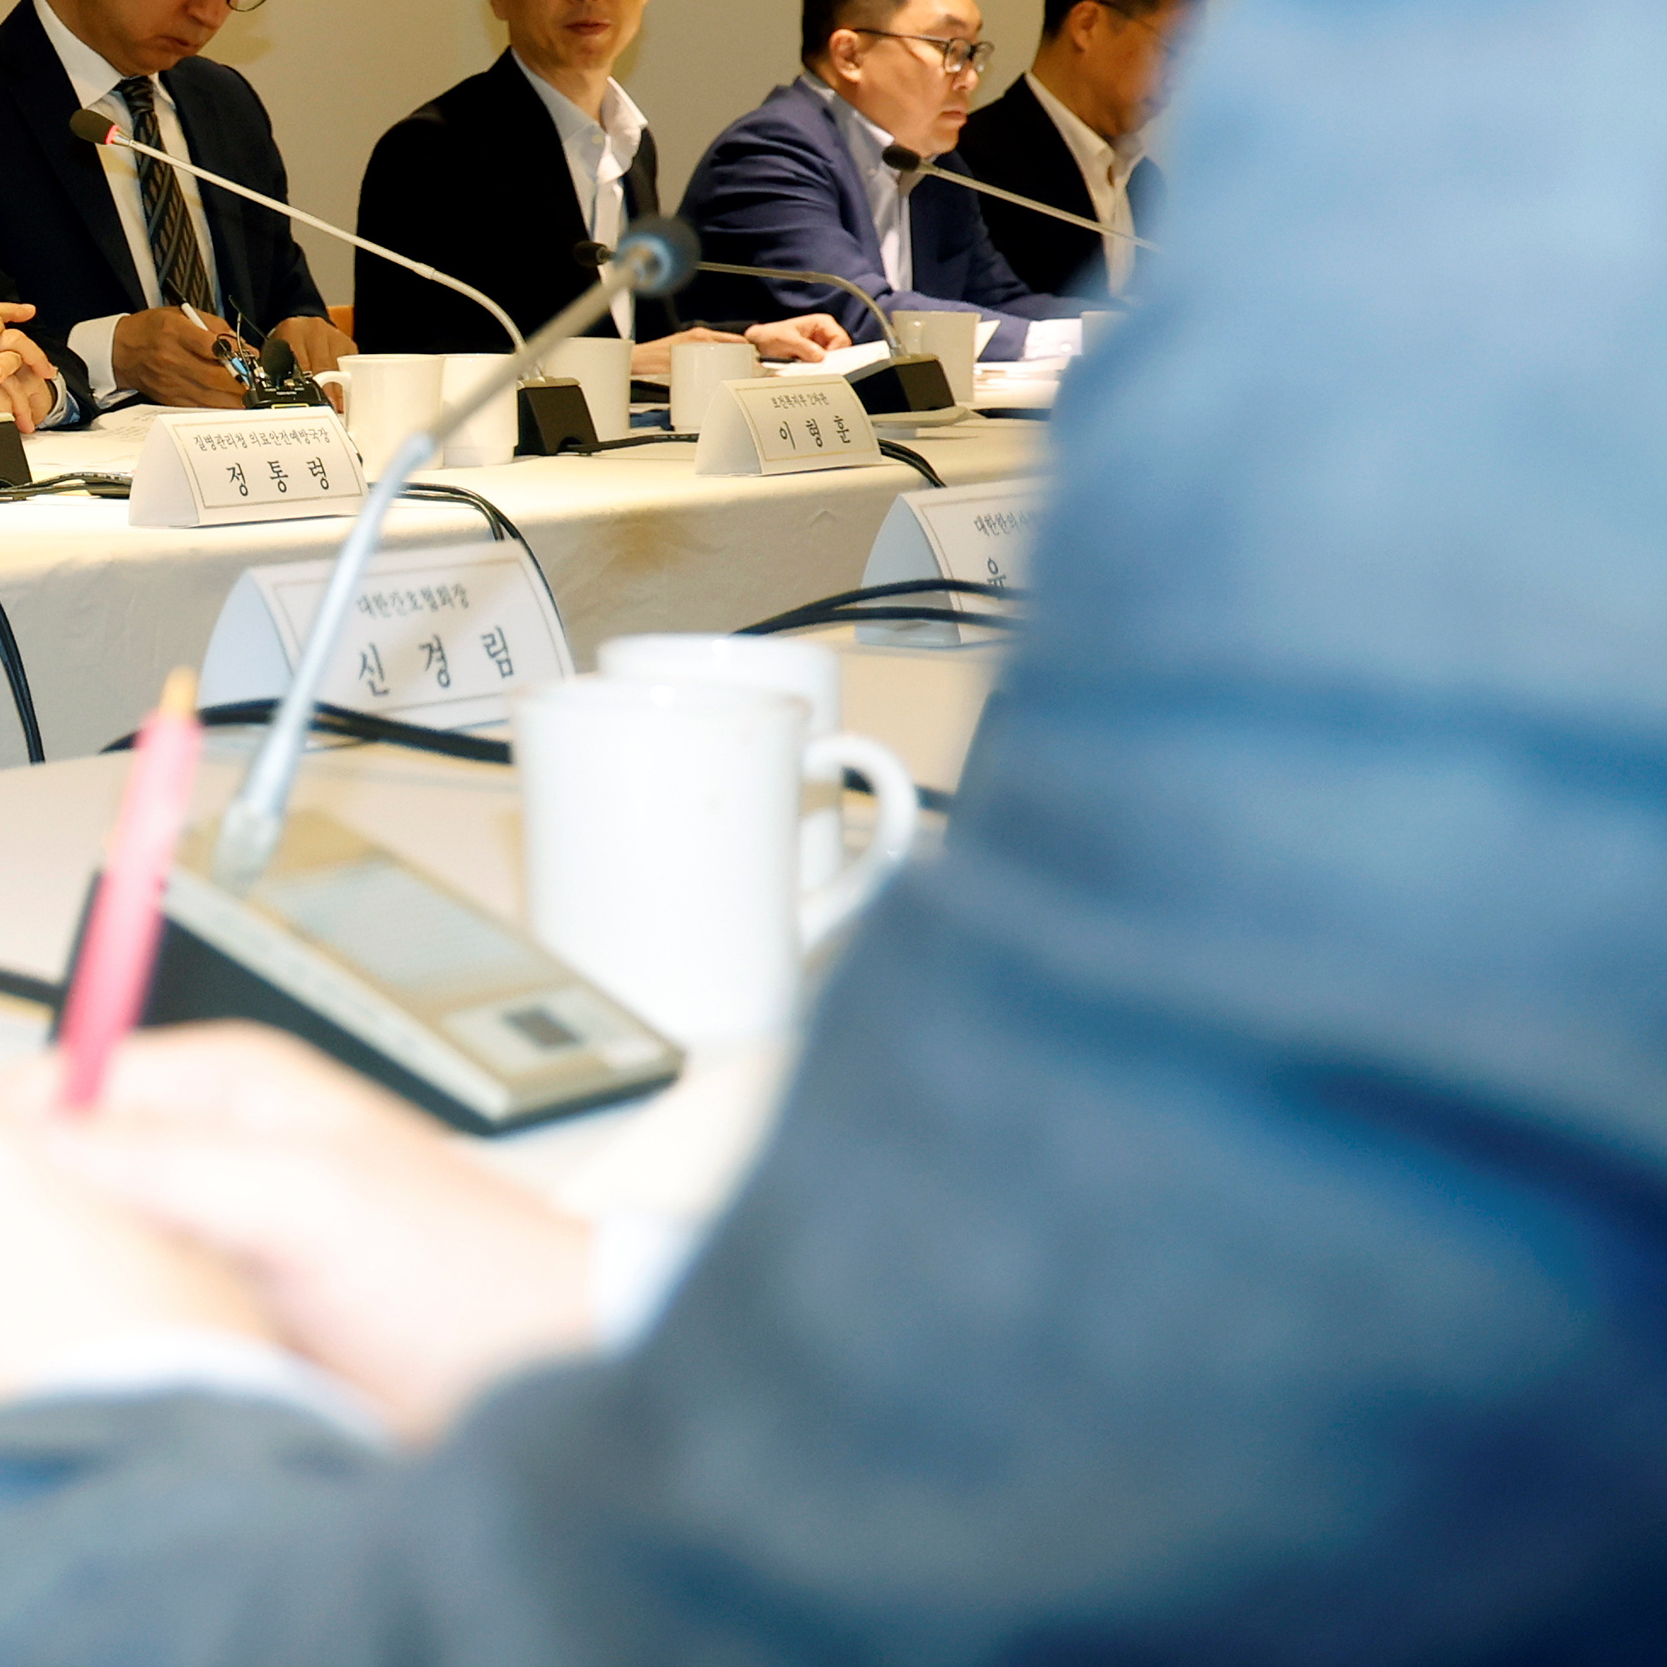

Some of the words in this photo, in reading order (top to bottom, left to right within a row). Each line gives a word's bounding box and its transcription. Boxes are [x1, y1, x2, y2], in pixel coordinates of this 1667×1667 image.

[193, 432, 248, 452] 질병관리청
[249, 427, 331, 448] 의료안전예방국장
[226, 457, 330, 497] 정통령
[357, 625, 516, 697] 신경림
